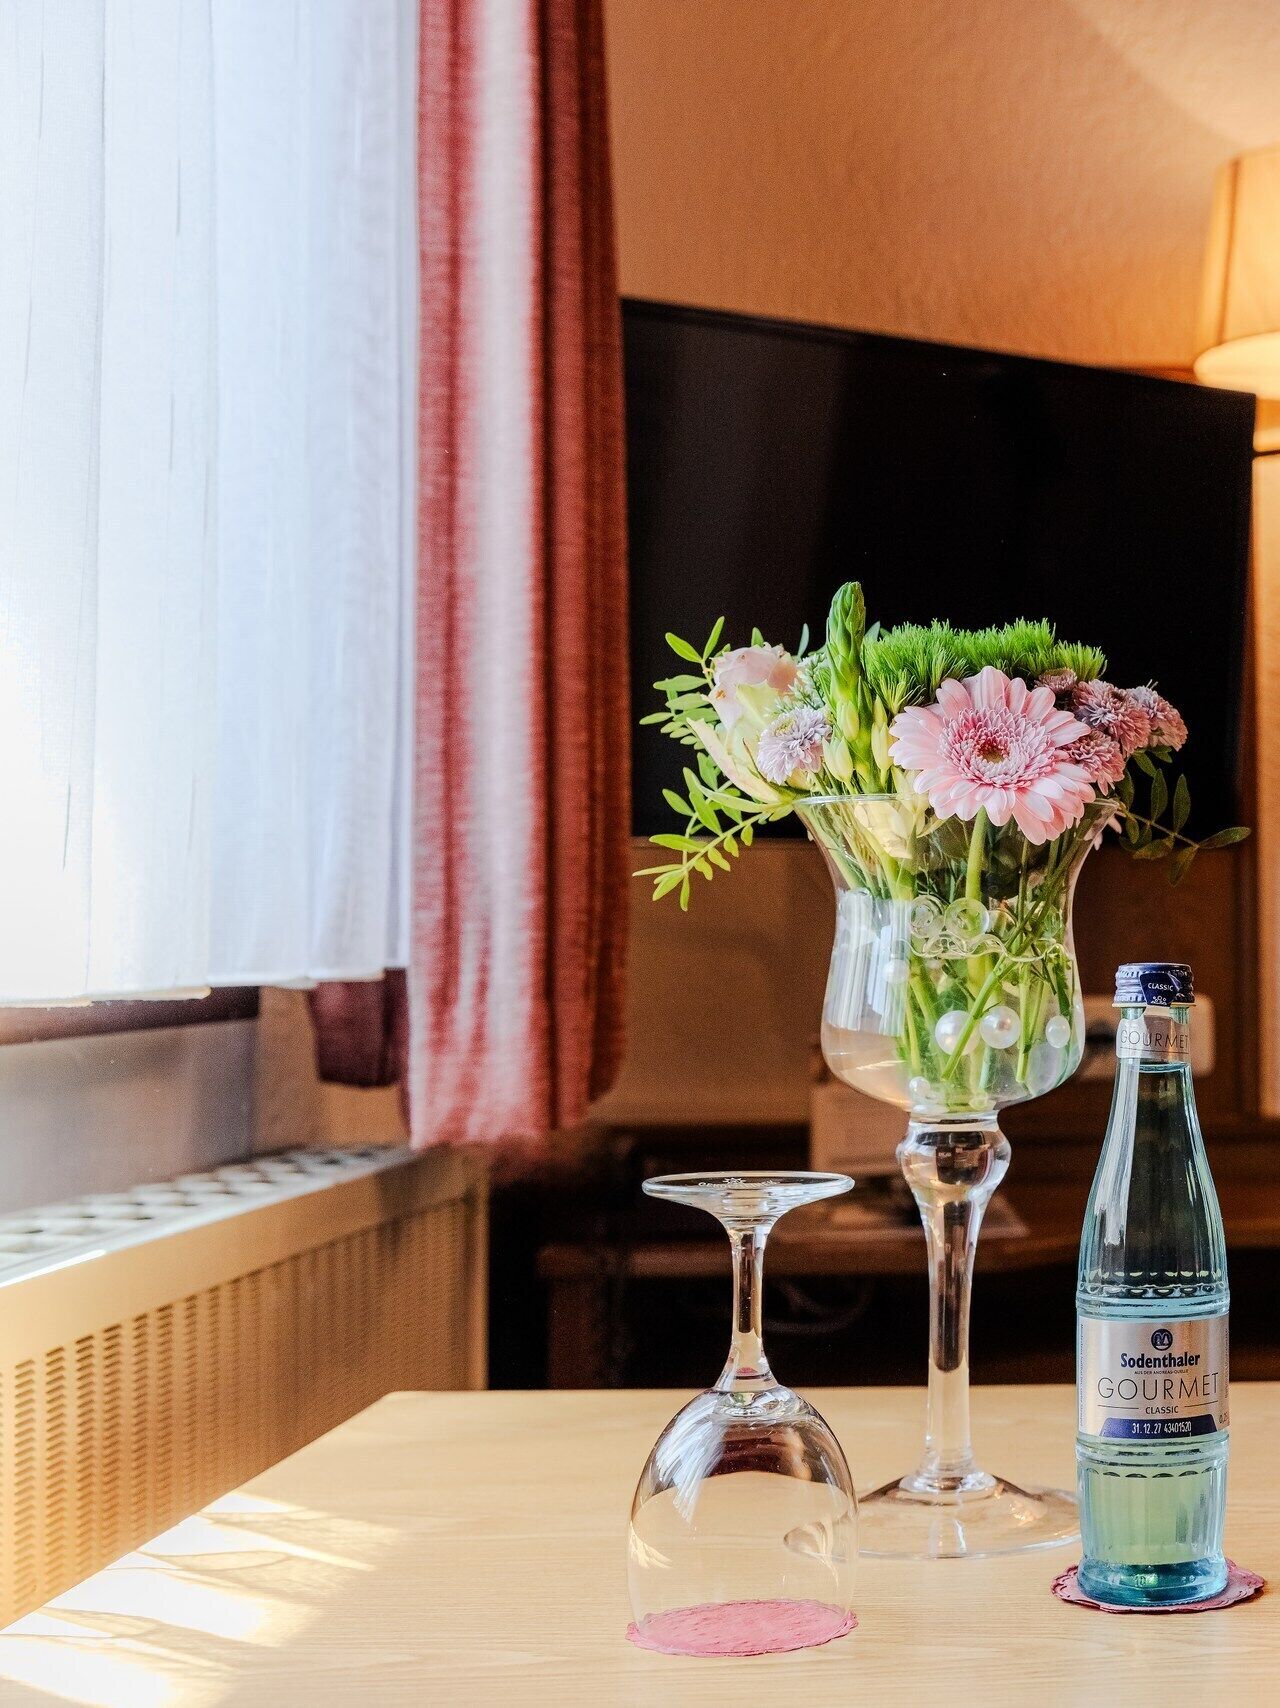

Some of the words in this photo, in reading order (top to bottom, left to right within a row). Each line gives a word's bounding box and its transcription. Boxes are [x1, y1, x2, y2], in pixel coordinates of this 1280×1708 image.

[1147, 982, 1174, 992] CLASSIC
[1120, 1029, 1189, 1049] GOURMET
[1120, 1351, 1201, 1369] Sodenthaler
[1097, 1372, 1219, 1401] GOURMET
[1145, 1406, 1179, 1415] CLASSIC
